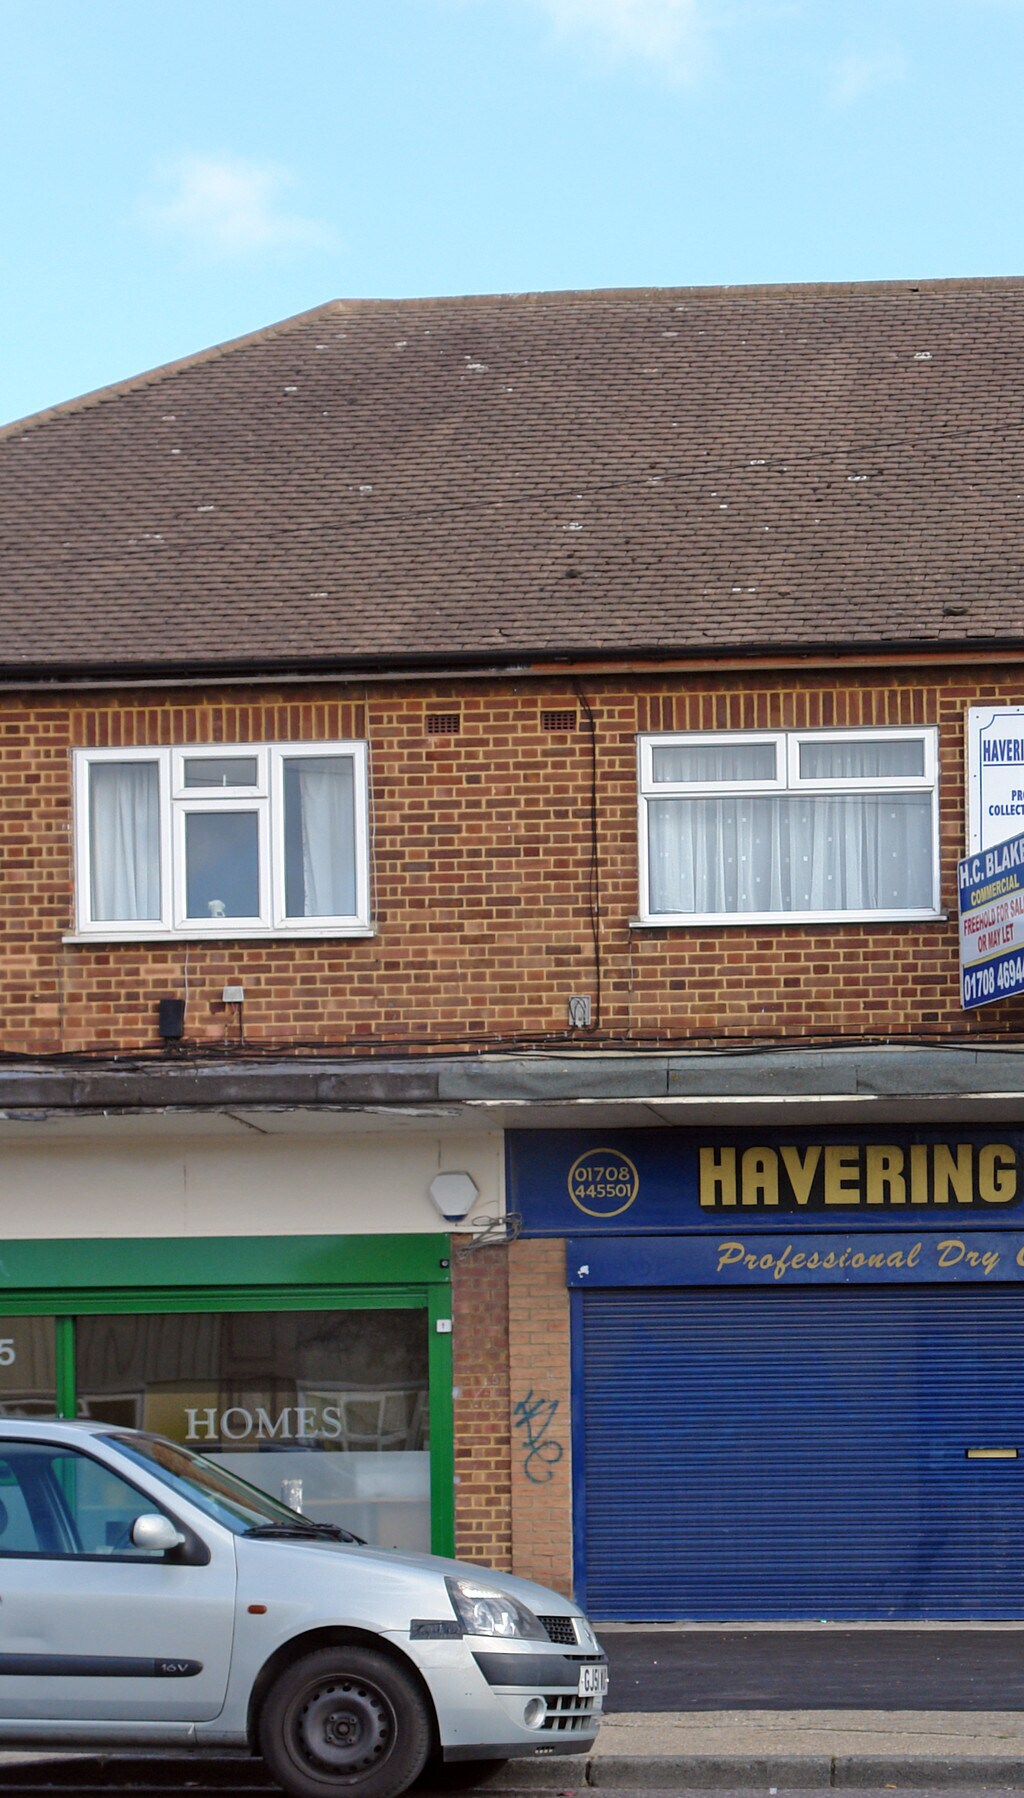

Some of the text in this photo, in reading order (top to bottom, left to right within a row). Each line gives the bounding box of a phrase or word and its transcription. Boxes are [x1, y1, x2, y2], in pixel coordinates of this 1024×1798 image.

[960, 858, 985, 889] H.C.
[971, 873, 1019, 906] COMMERCIAL
[964, 907, 996, 936] FREEHOLD
[996, 904, 1009, 923] FOR
[978, 923, 1014, 952] OR MAY LET
[964, 966, 995, 1001] 01708
[574, 1166, 630, 1182] 01708
[700, 1143, 1017, 1206] HAVERING
[574, 1184, 632, 1199] 445501
[717, 1241, 922, 1280] Professional
[937, 1239, 1000, 1275] Dry
[185, 1406, 342, 1440] HOMES
[161, 1663, 189, 1672] 16V
